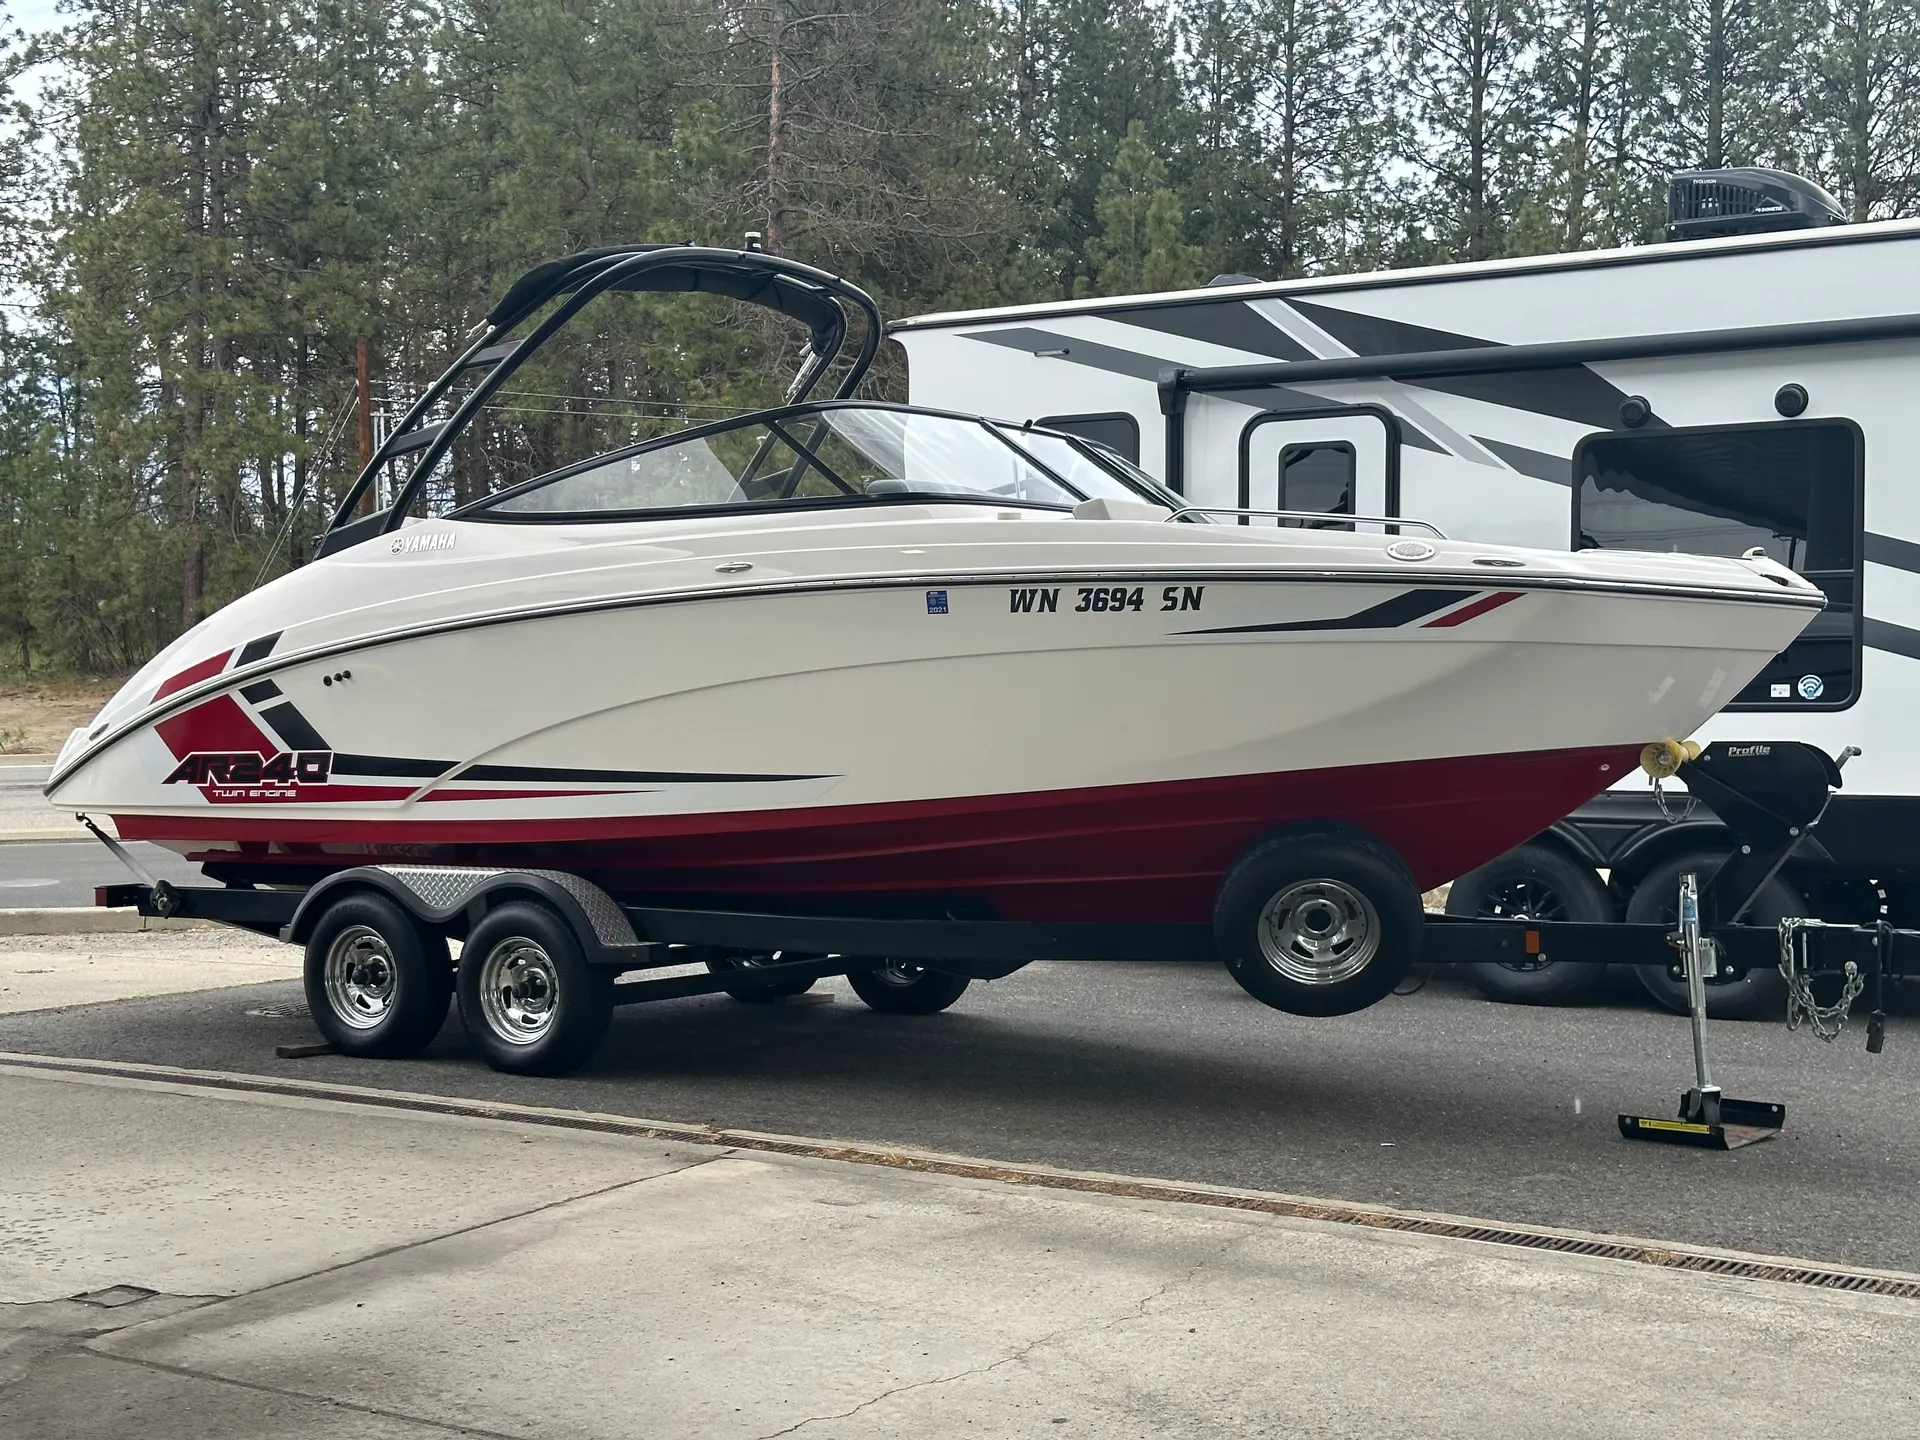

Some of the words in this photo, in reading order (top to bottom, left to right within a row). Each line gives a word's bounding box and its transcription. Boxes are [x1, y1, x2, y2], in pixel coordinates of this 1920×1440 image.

[405, 532, 456, 553] YAMAHA
[1009, 588, 1062, 613] WN
[1075, 587, 1144, 612] 3694
[1159, 586, 1206, 611] SN
[1728, 745, 1771, 757] Profile
[161, 752, 332, 785] AR240
